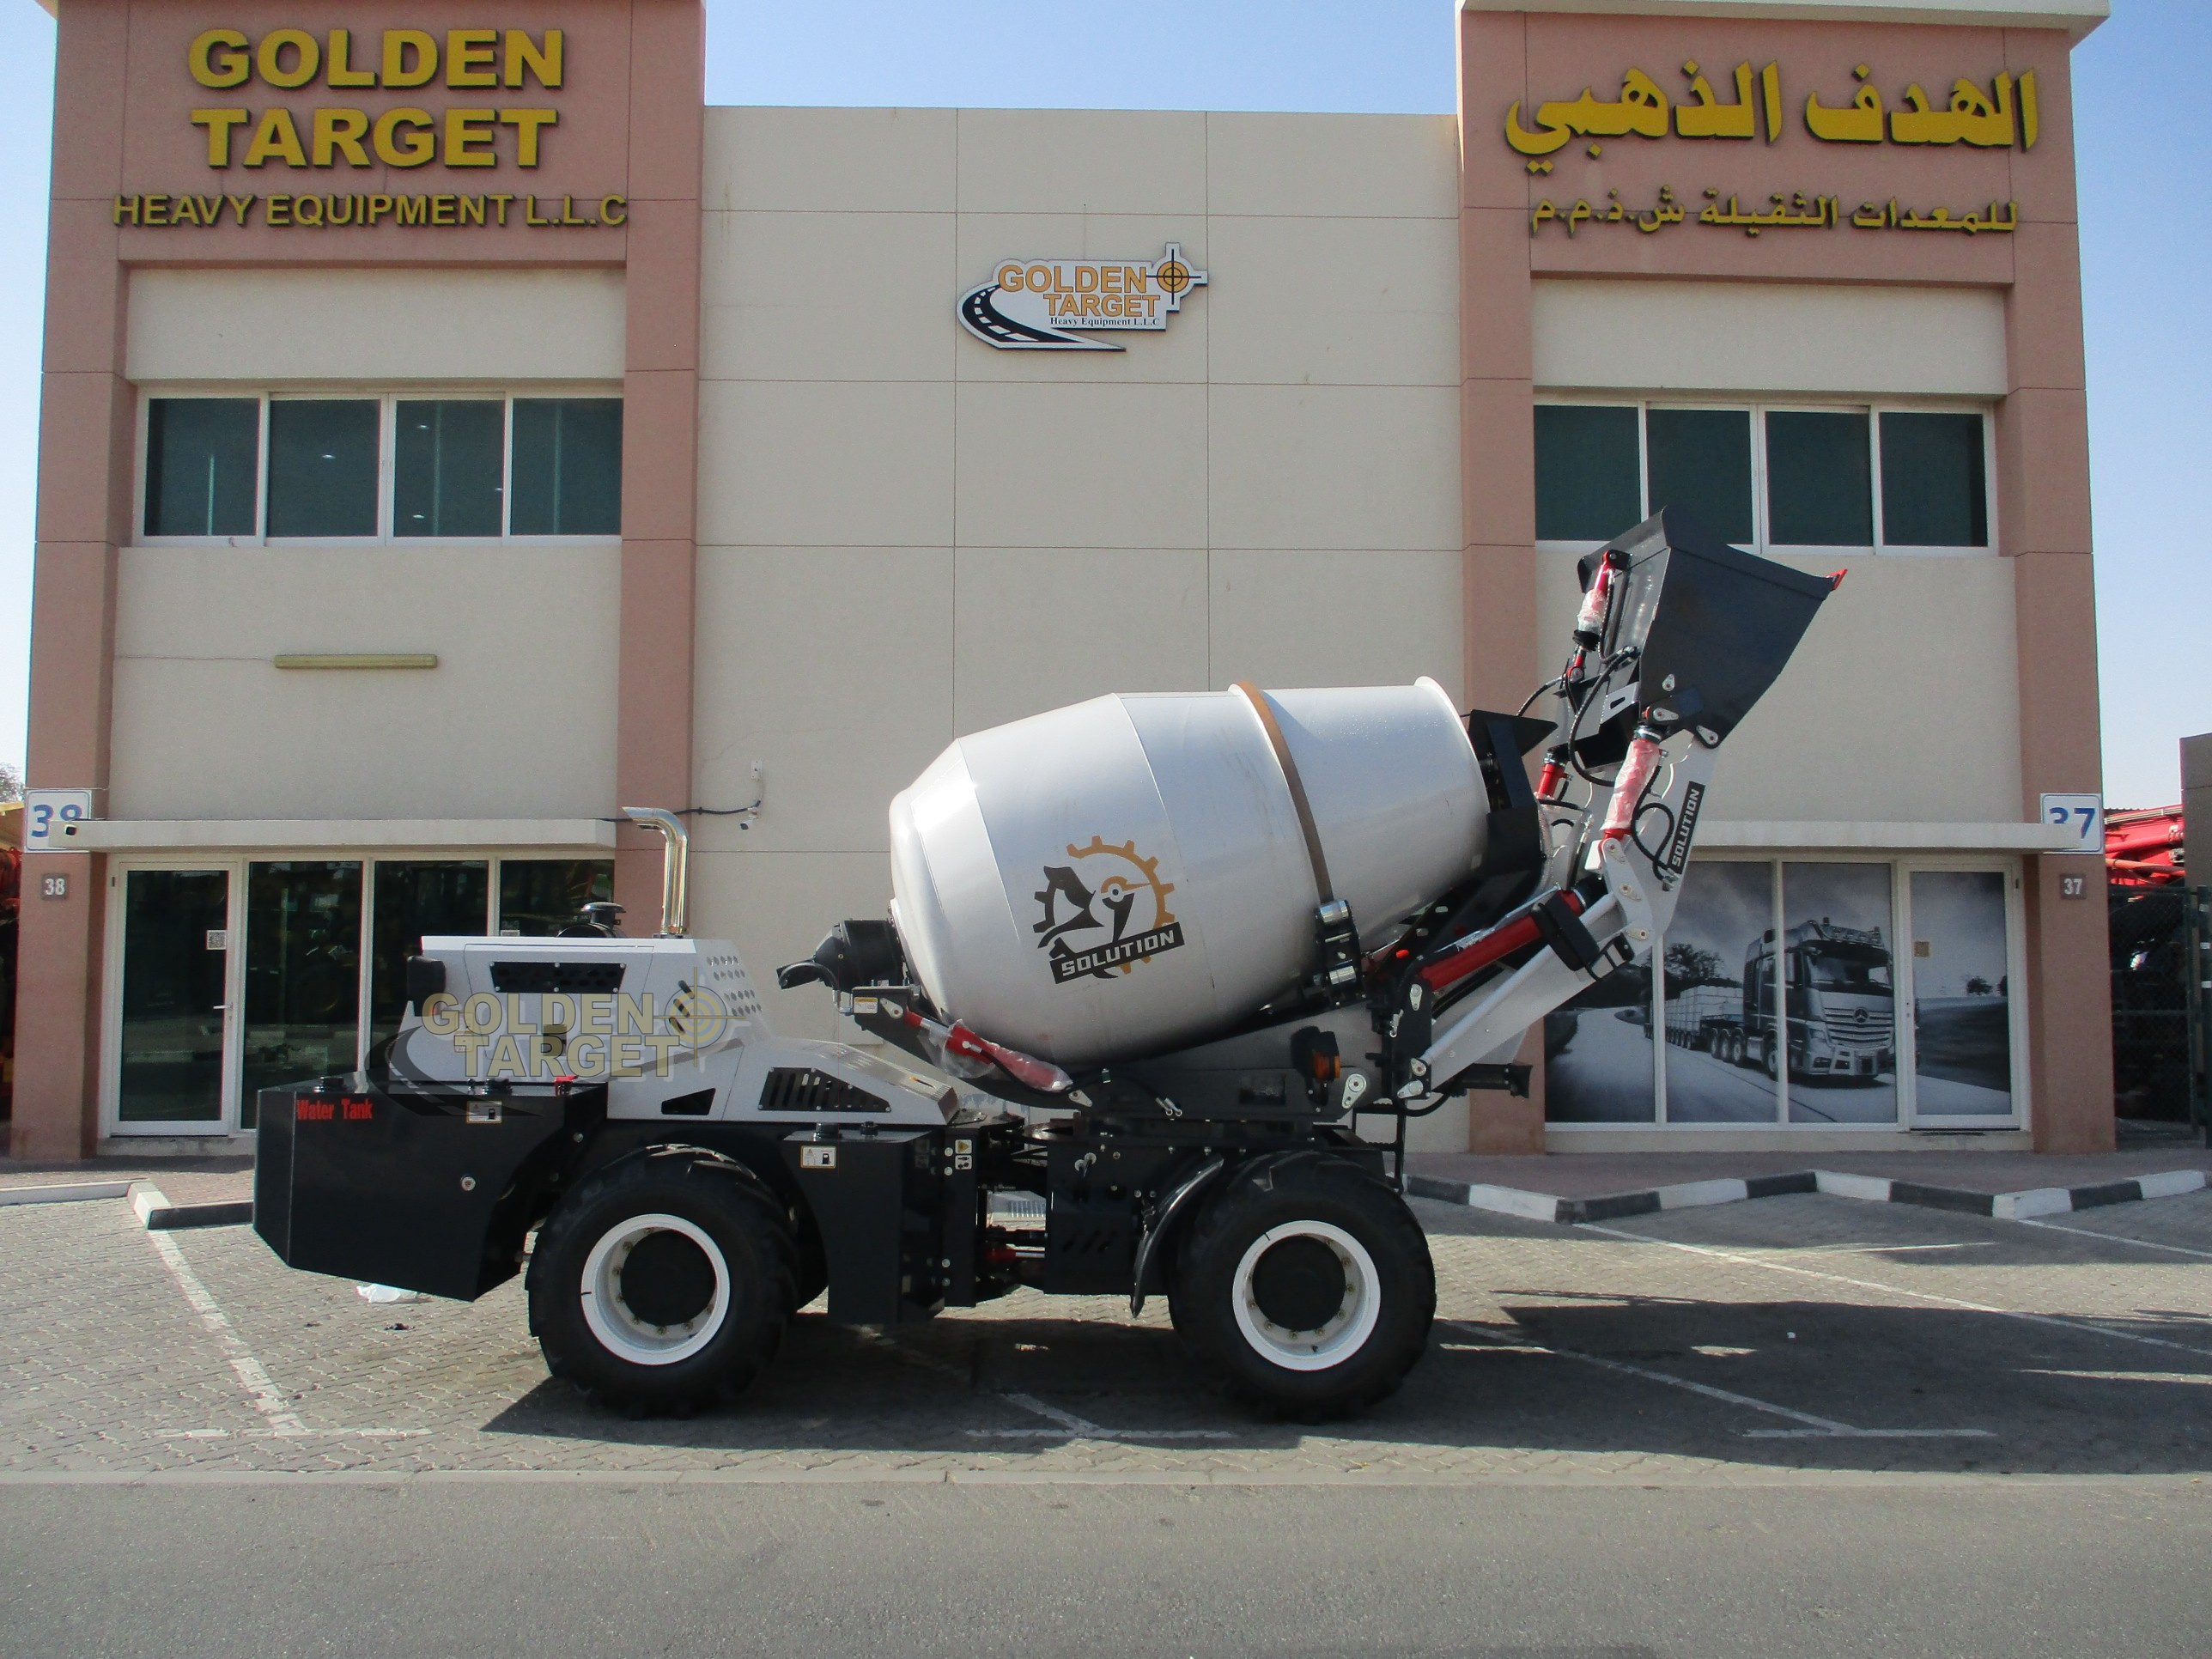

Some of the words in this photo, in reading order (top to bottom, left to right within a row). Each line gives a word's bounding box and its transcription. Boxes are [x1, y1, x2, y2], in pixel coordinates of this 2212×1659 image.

[187, 28, 564, 89] GOLDEN
[1504, 58, 1784, 175] الذهبي
[1804, 62, 2038, 152] الهدف
[190, 107, 558, 168] TARGET
[112, 194, 253, 227] HEAVY
[265, 194, 514, 227] EQUIPMENT
[525, 194, 628, 227] L.L.C
[1698, 190, 1839, 238] الثقيلة
[1850, 197, 2018, 235] للمعدات
[998, 264, 1147, 294] GOLDEN
[1042, 294, 1161, 318] TARGET
[1050, 317, 1079, 326] Heavy
[1081, 317, 1131, 326] Equipment
[1133, 318, 1160, 326] L.L.C
[1678, 788, 1700, 868] SOLUTION
[45, 878, 66, 896] 38
[2063, 878, 2083, 895] 37
[1061, 930, 1175, 976] SOLUTION
[296, 1099, 335, 1121] Water
[341, 1098, 374, 1120] Tank
